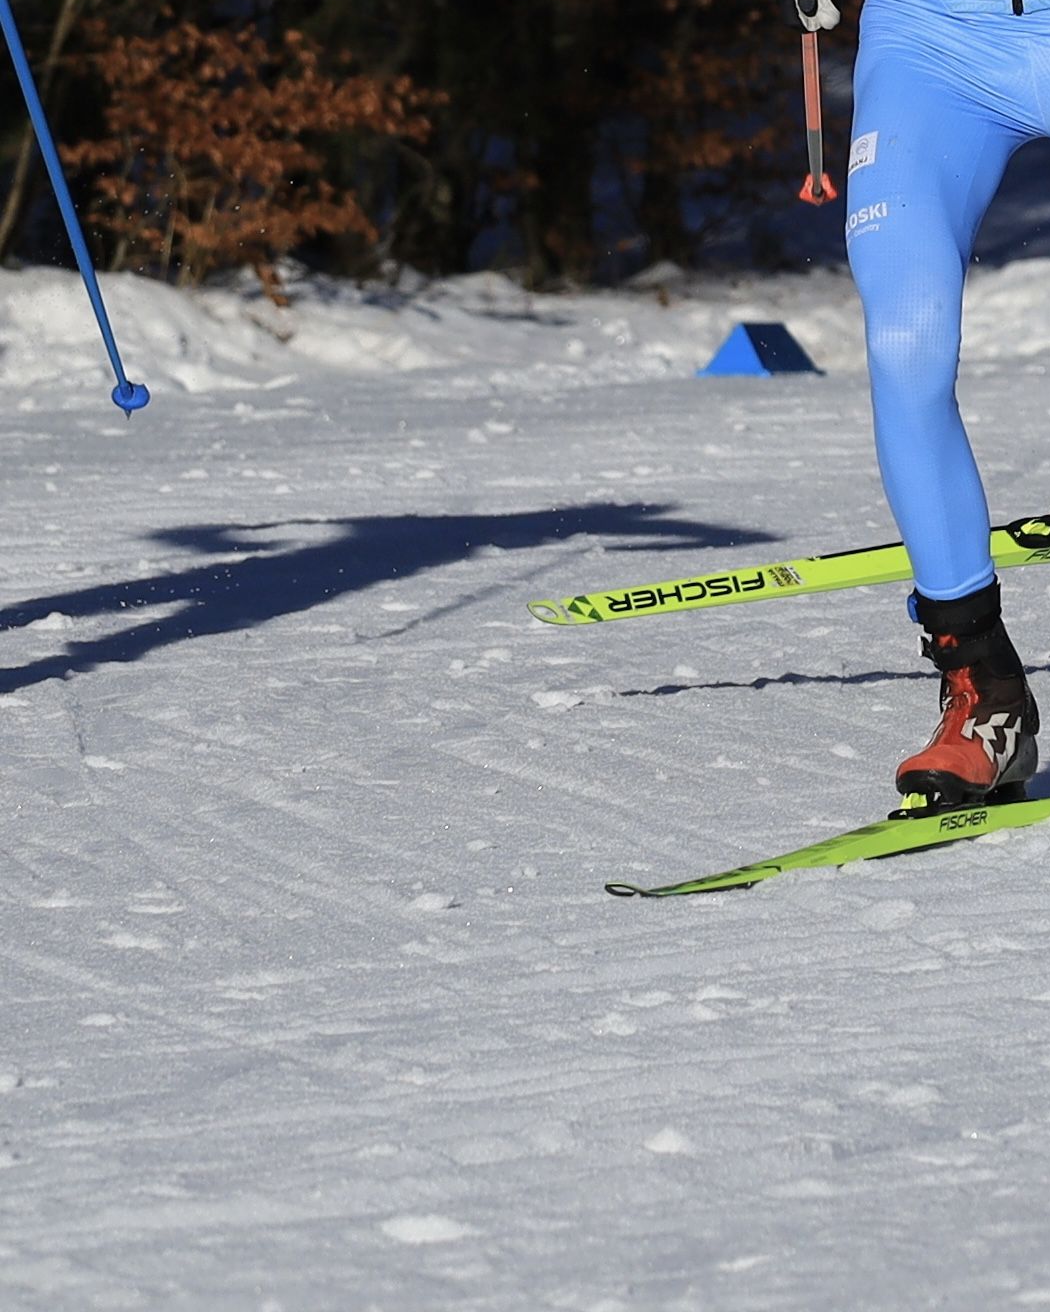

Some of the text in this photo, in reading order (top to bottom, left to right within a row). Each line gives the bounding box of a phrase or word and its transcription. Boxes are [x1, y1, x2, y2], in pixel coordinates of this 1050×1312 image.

[846, 201, 888, 229] OSKI
[604, 571, 766, 613] FISCHER
[939, 810, 989, 832] FISCHER
